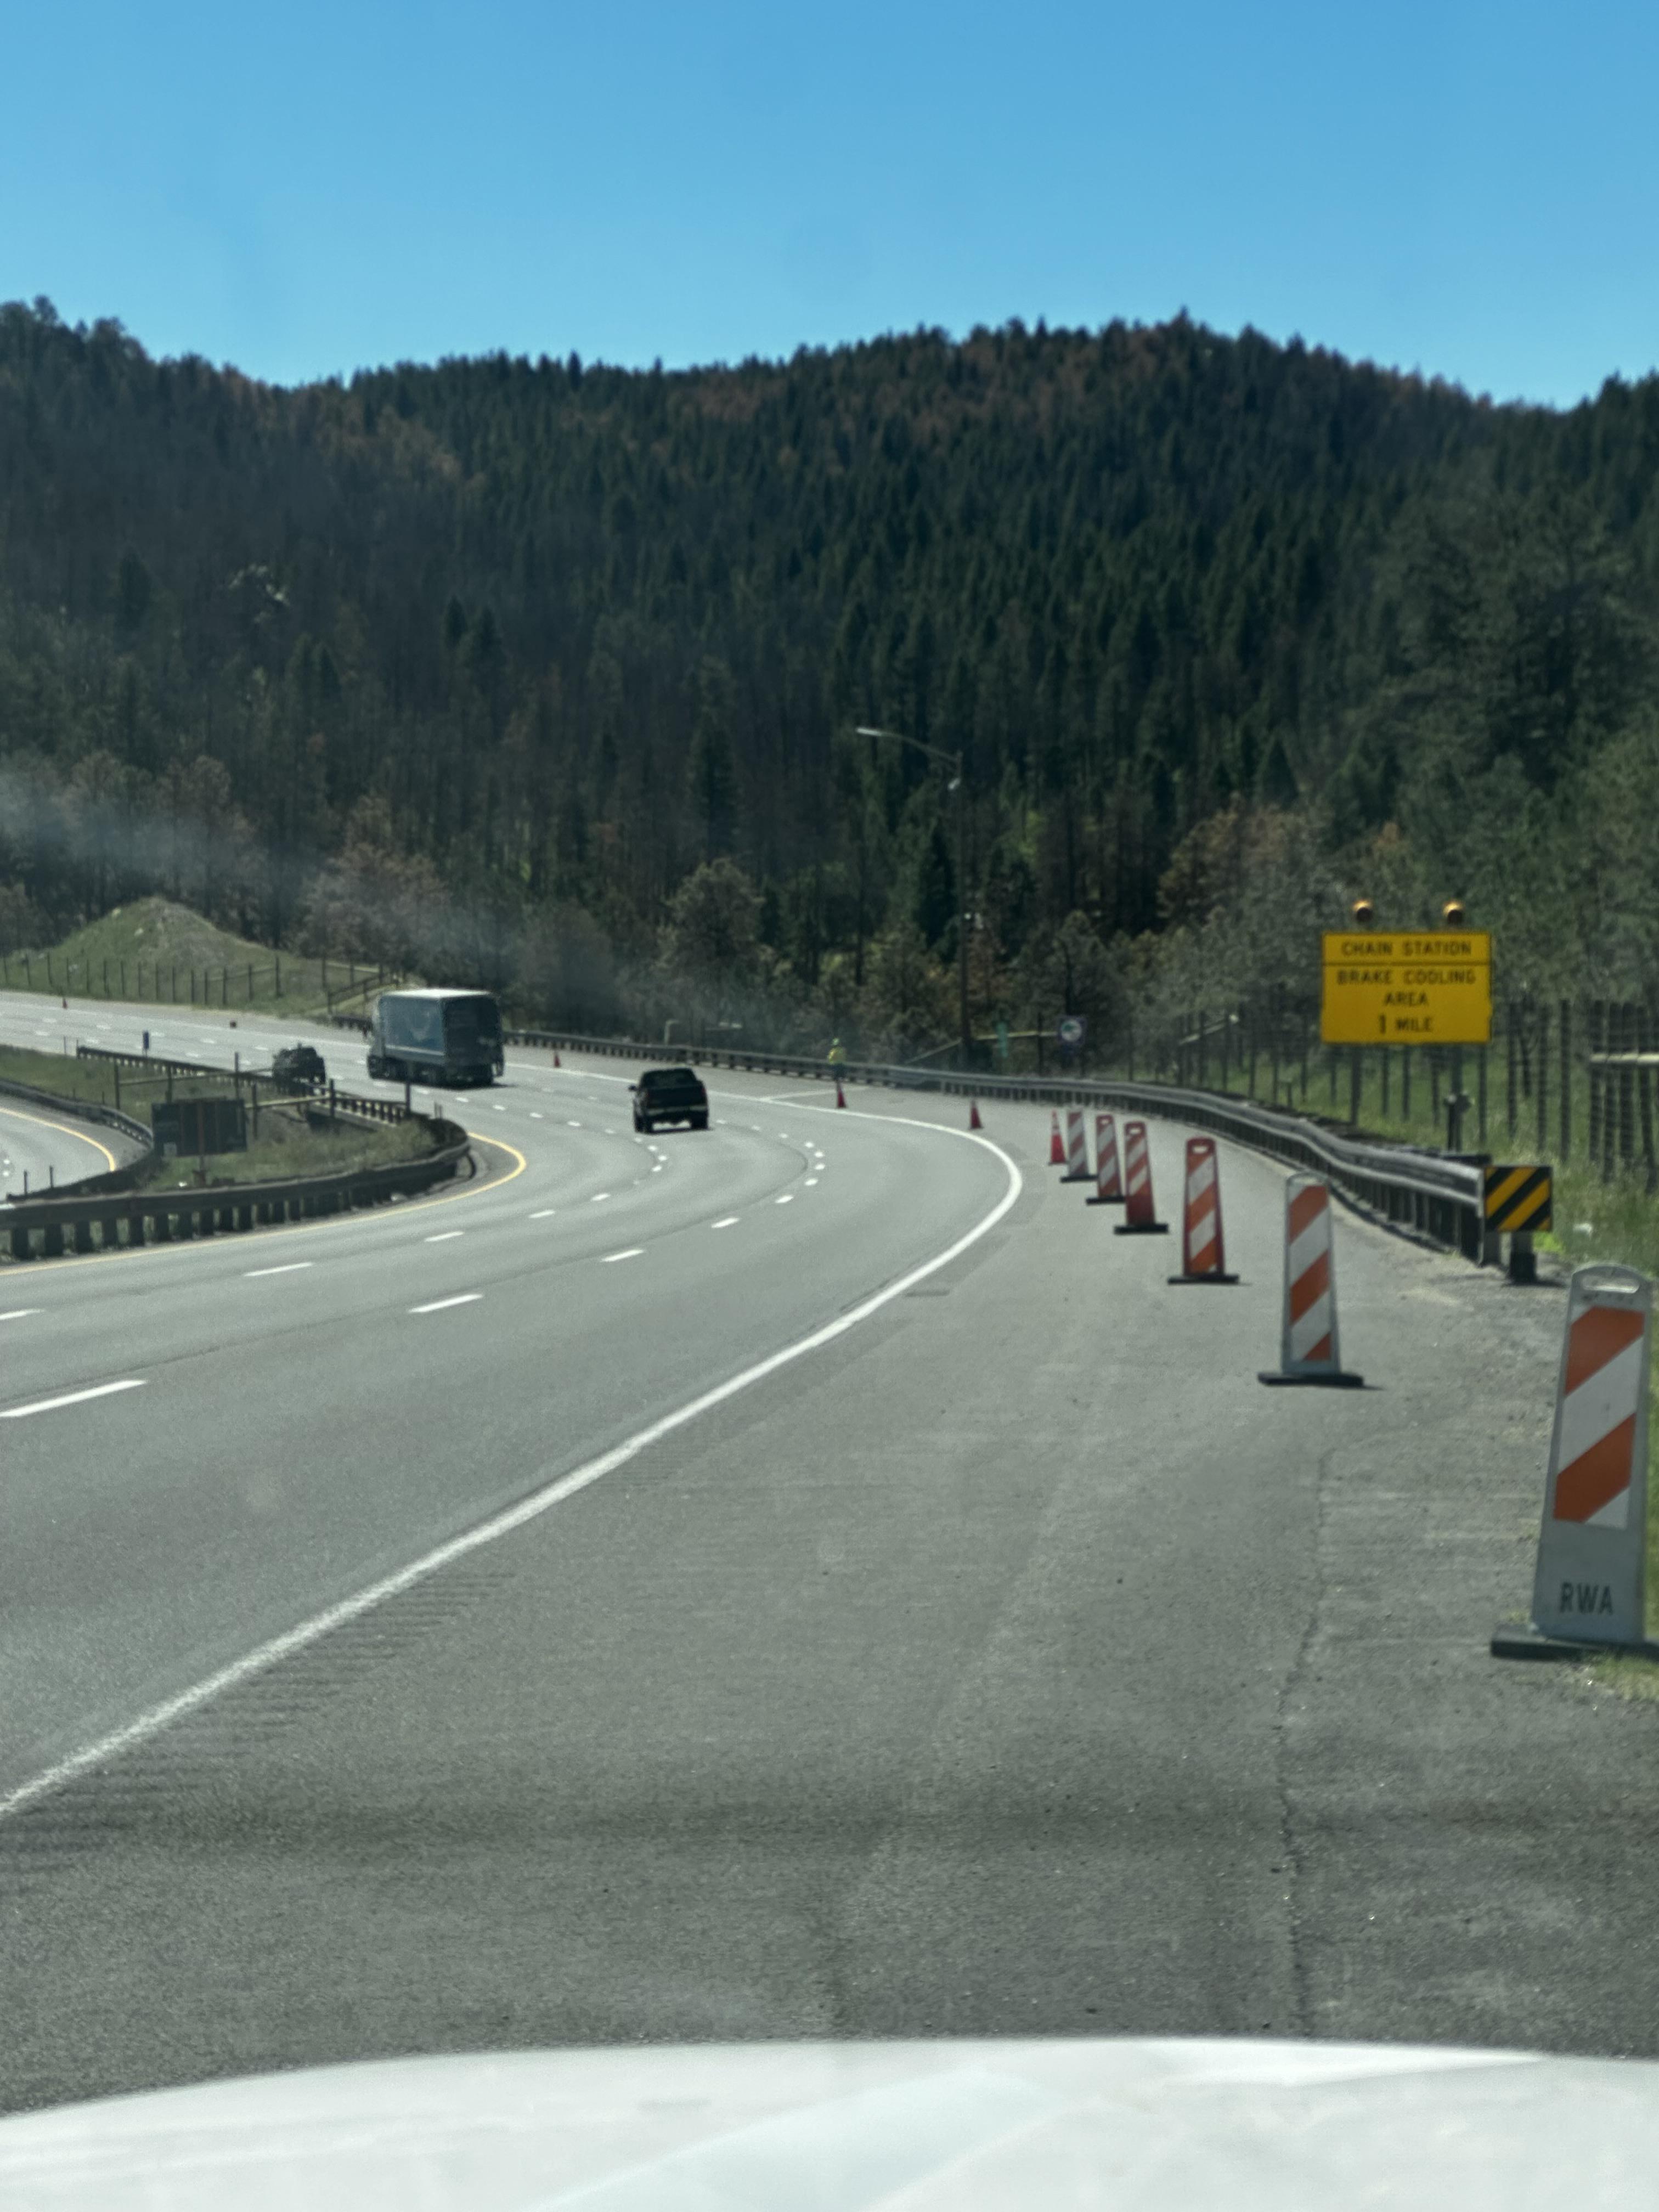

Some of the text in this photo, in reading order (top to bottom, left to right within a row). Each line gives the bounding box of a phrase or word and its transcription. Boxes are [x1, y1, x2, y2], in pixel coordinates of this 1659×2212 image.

[1341, 940, 1471, 956] CHAIN STATION
[1337, 969, 1476, 985] BRAKE COOLING
[1384, 992, 1427, 1006] AREA
[1379, 1014, 1432, 1034] 1 MILE
[1560, 1582, 1613, 1615] RWA
